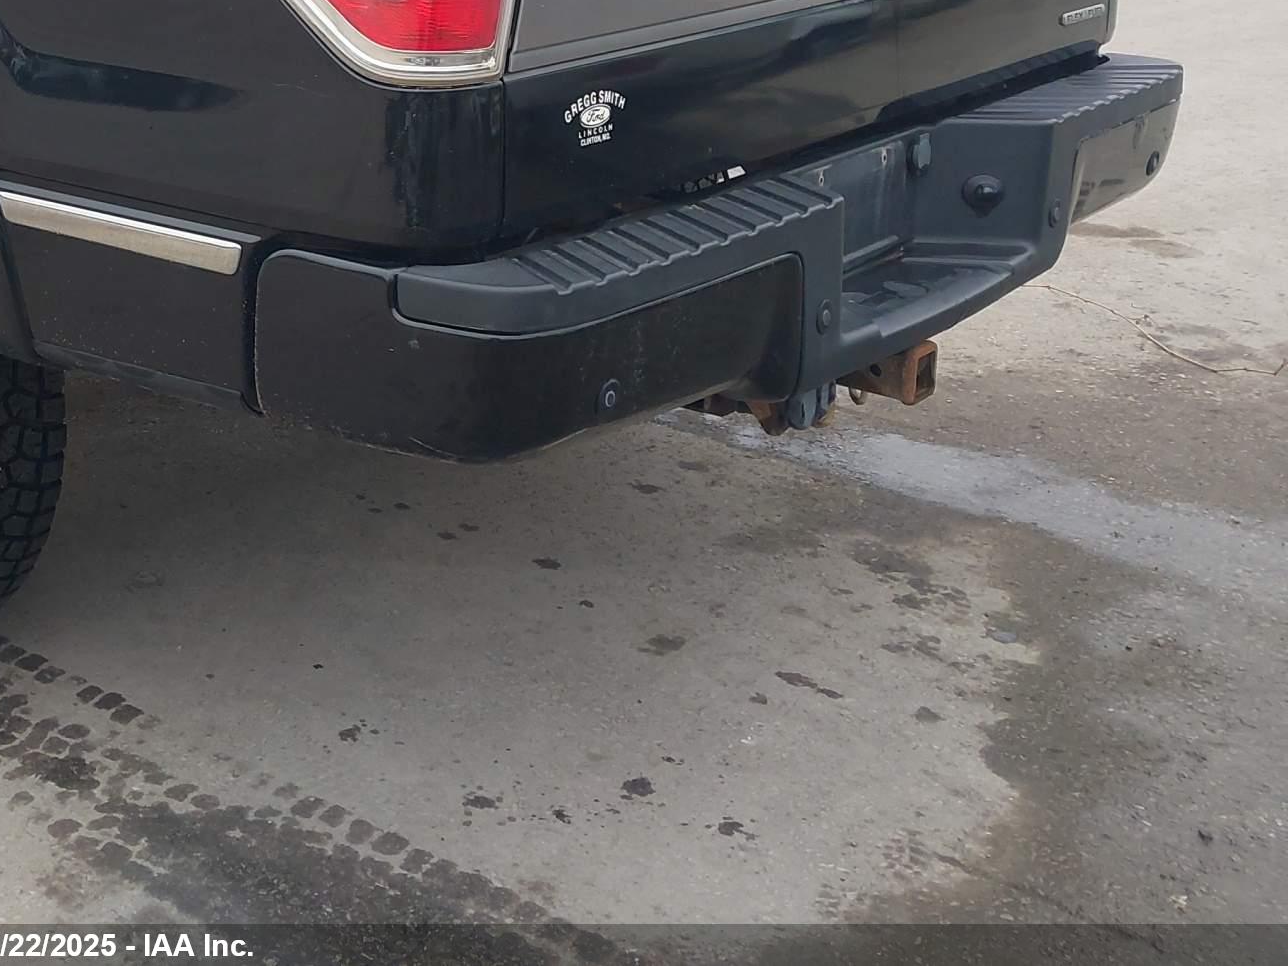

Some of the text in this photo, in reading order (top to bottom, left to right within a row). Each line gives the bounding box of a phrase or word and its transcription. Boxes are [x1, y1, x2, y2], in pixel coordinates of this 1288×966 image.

[565, 90, 626, 123] GREGG SMITH
[586, 109, 605, 123] Ford
[579, 123, 613, 138] LINCOLN
